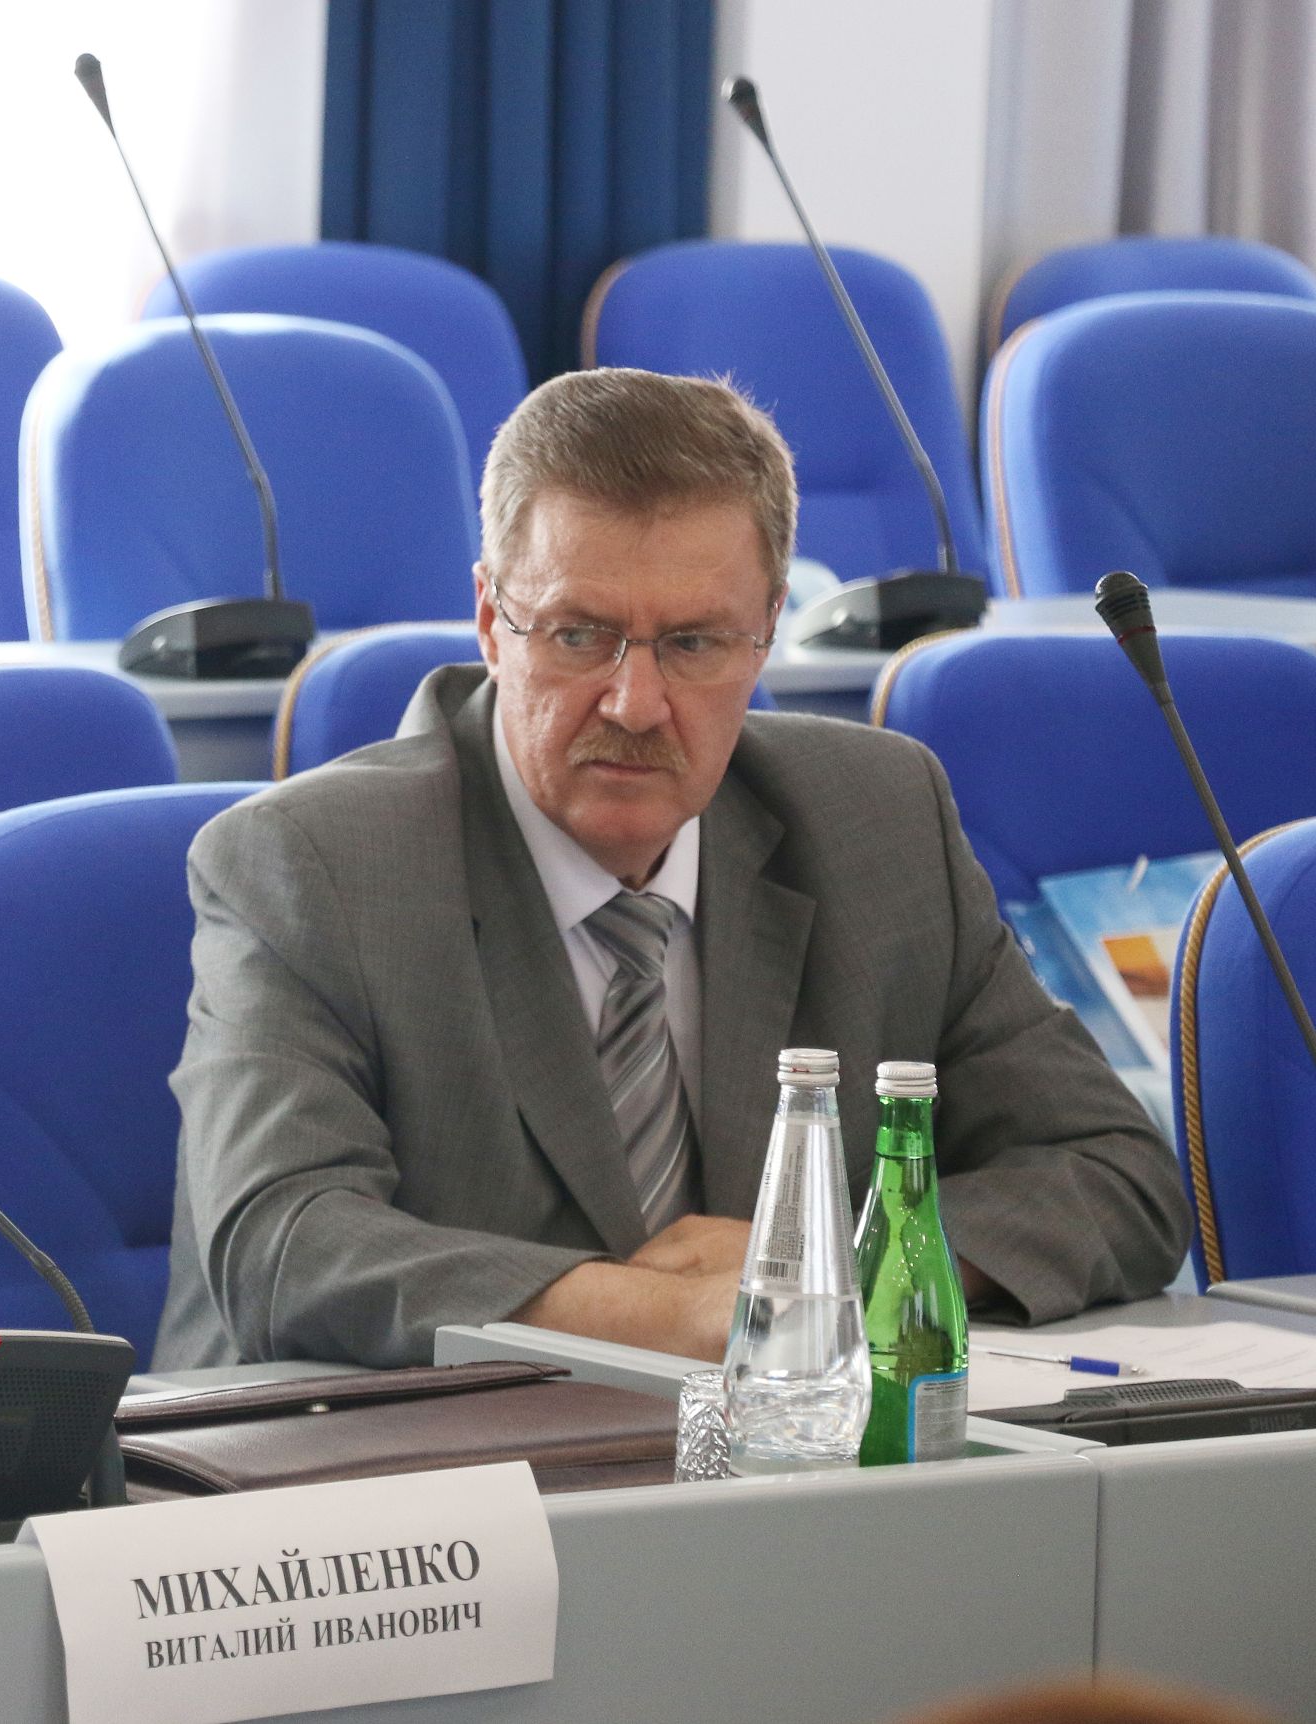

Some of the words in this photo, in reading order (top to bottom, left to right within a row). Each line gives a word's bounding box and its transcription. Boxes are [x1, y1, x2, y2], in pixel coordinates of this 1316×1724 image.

[1249, 1412, 1304, 1432] PHILIPS
[131, 1540, 480, 1620] МИХАЙЛЕНКО
[145, 1617, 297, 1670] ВИТАЛИЙ
[313, 1602, 483, 1648] ИВАНОВИЧ
